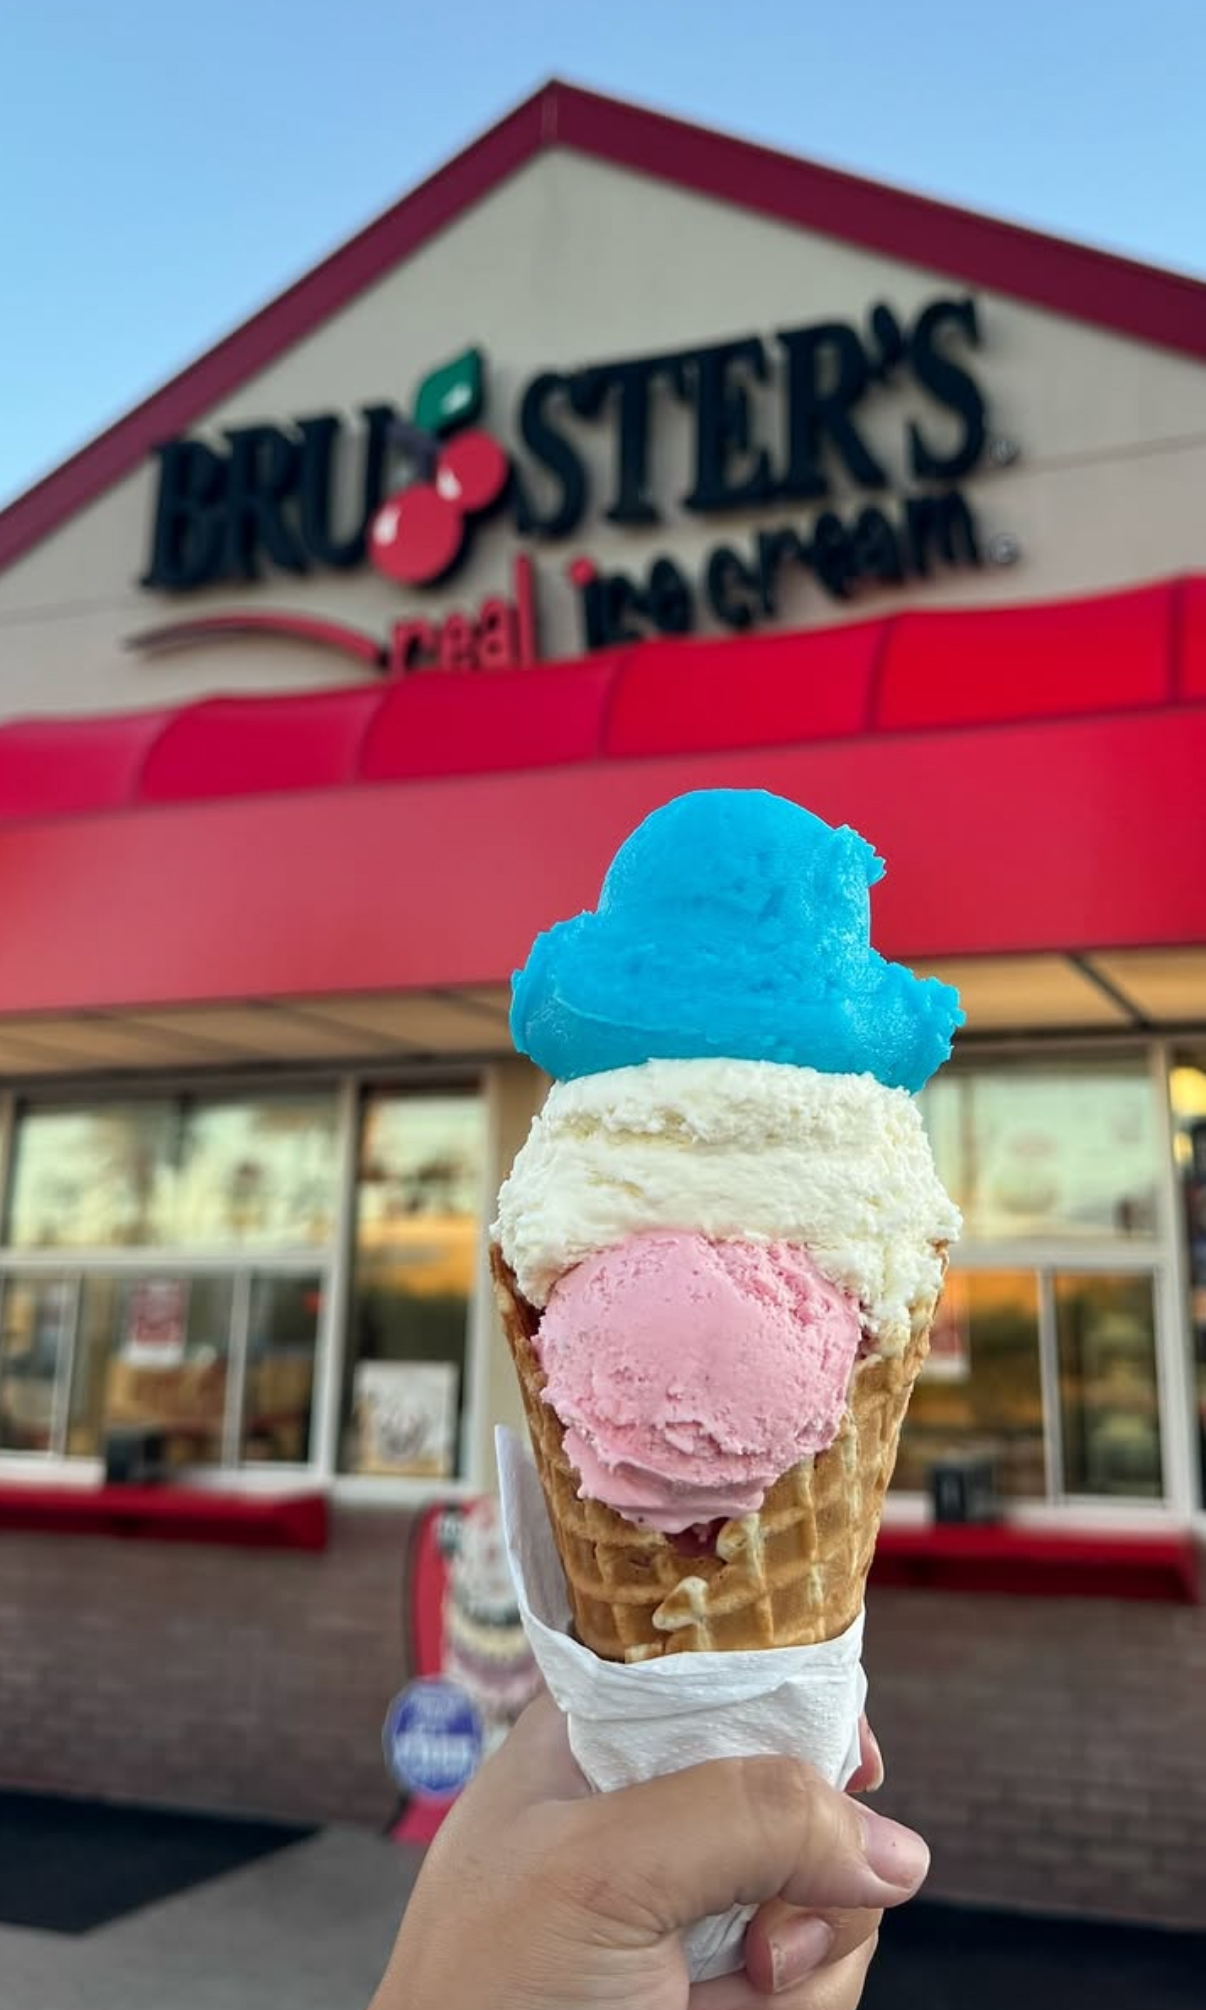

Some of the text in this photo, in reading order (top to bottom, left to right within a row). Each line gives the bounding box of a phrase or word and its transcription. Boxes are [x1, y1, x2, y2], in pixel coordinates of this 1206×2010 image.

[141, 294, 986, 590] BRUSTER'S
[390, 489, 983, 674] real ice cream
